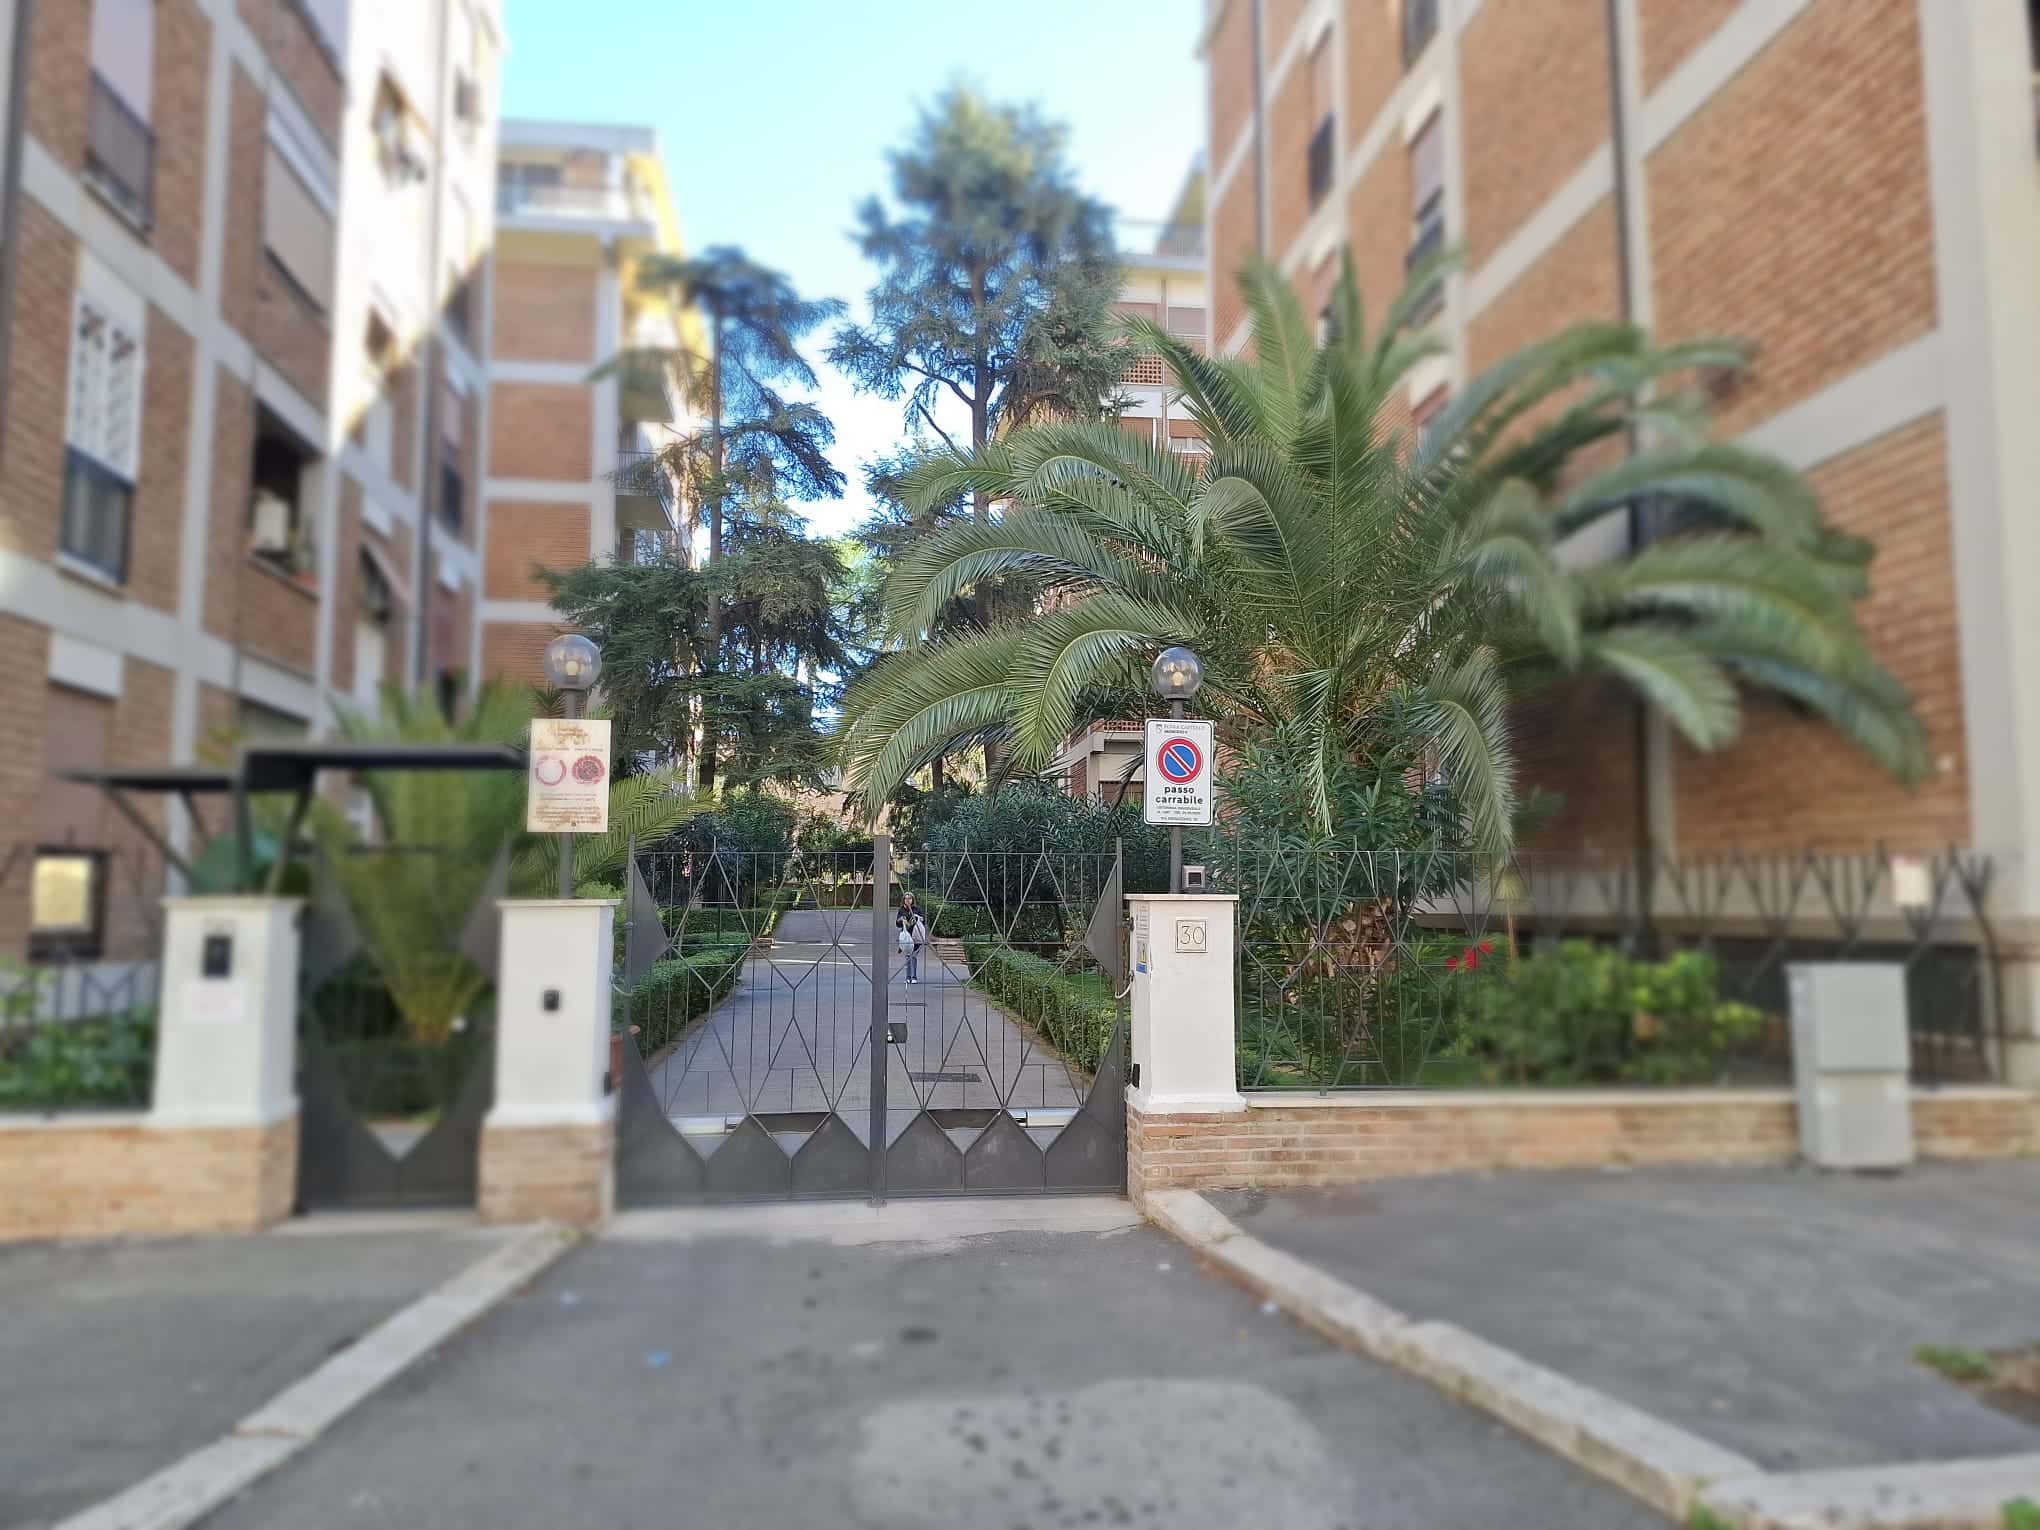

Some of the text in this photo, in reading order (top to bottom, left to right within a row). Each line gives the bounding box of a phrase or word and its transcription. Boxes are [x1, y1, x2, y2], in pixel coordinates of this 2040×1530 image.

[1164, 786, 1195, 795] passo
[1155, 795, 1203, 805] carrabile
[1180, 925, 1204, 945] 30
